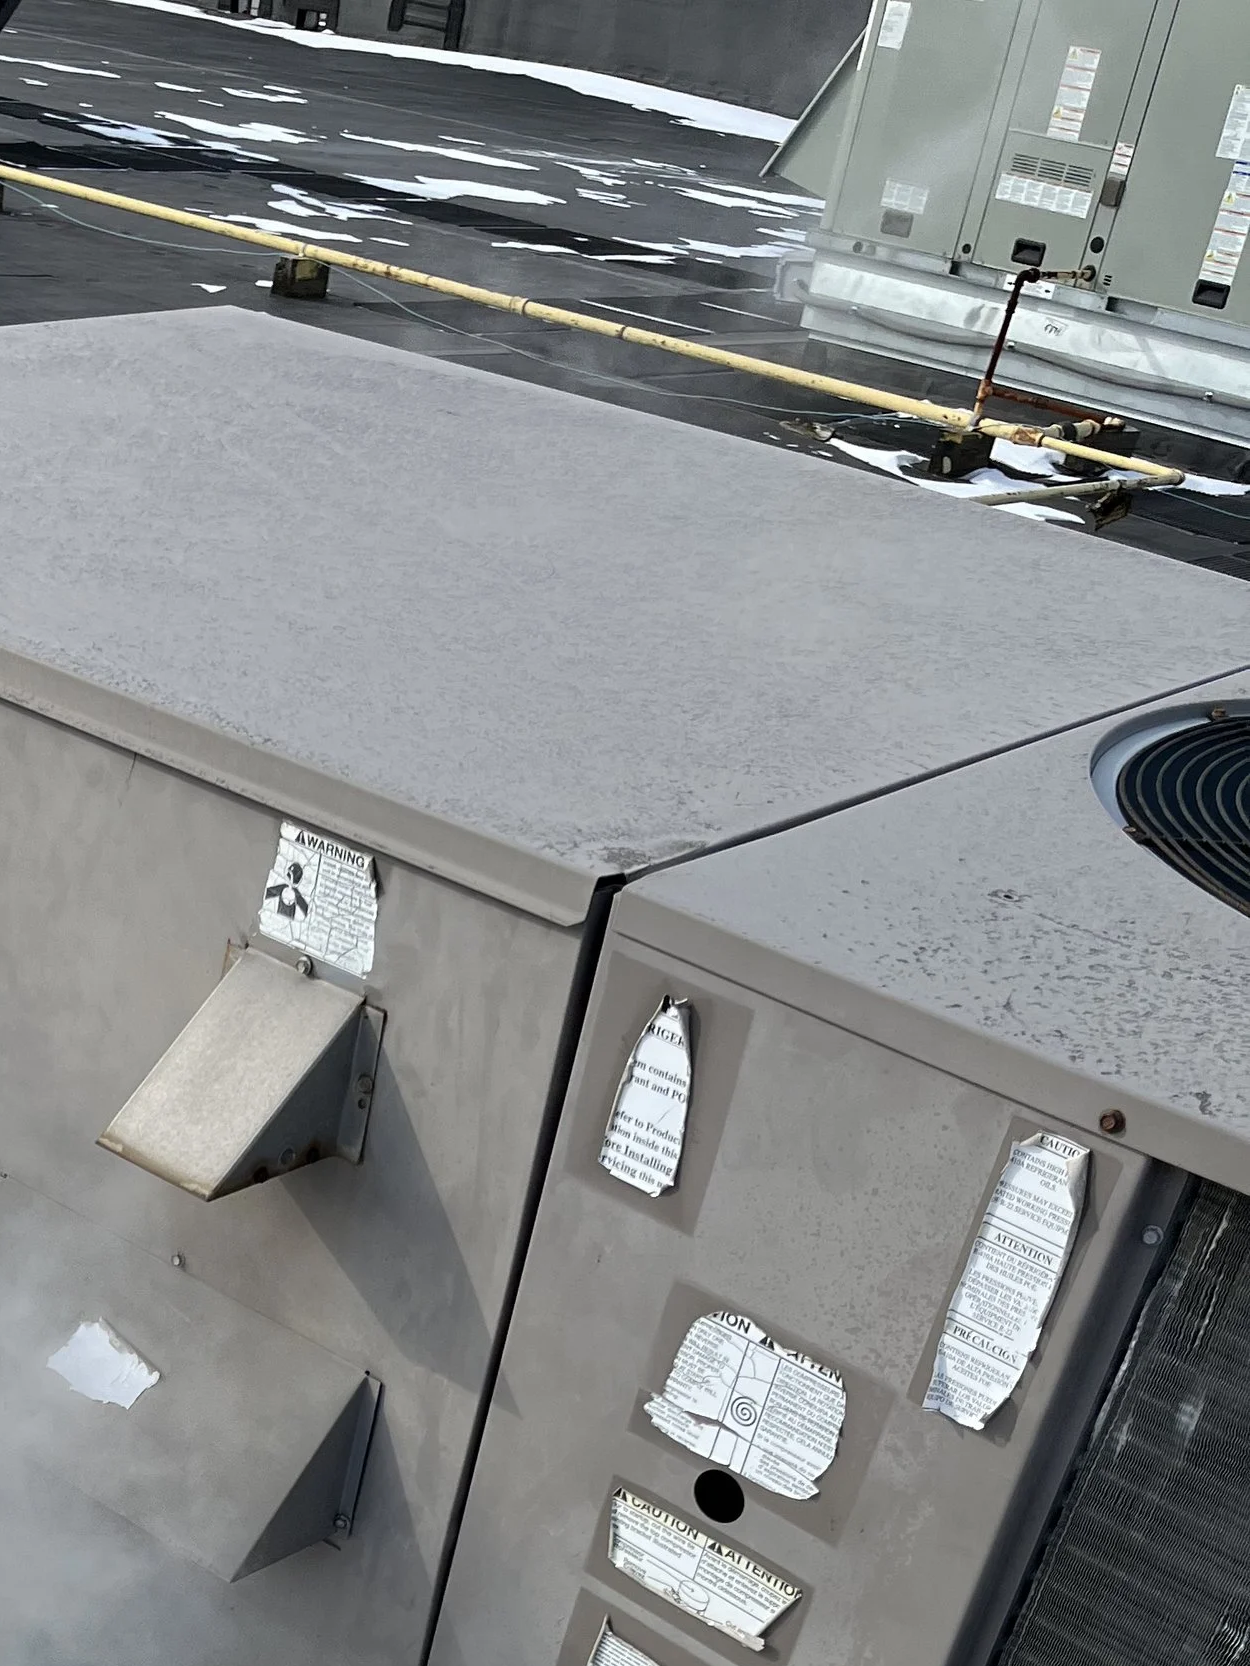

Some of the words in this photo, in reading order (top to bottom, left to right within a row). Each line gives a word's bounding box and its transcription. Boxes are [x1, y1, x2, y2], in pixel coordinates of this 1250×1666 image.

[307, 833, 365, 868] WARNING
[647, 1066, 687, 1086] contains
[651, 1082, 669, 1096] and
[634, 1119, 643, 1129] to
[632, 1133, 659, 1151] inside
[661, 1144, 678, 1159] this
[623, 1144, 674, 1176] Installing
[1012, 1148, 1046, 1166] CONTAINS
[1046, 1163, 1064, 1175] HIGH
[638, 1170, 656, 1185] this
[1015, 1197, 1048, 1215] WORKING
[1032, 1194, 1048, 1206] MAY
[1013, 1206, 1042, 1222] SERVICE
[993, 1231, 1054, 1265] ATTENTION
[993, 1258, 1017, 1272] HAUTE
[713, 1311, 751, 1334] ION
[951, 1364, 979, 1380] ACEITES
[956, 1356, 965, 1366] DE
[966, 1362, 982, 1374] ALTA
[631, 1496, 698, 1540] CAUTION
